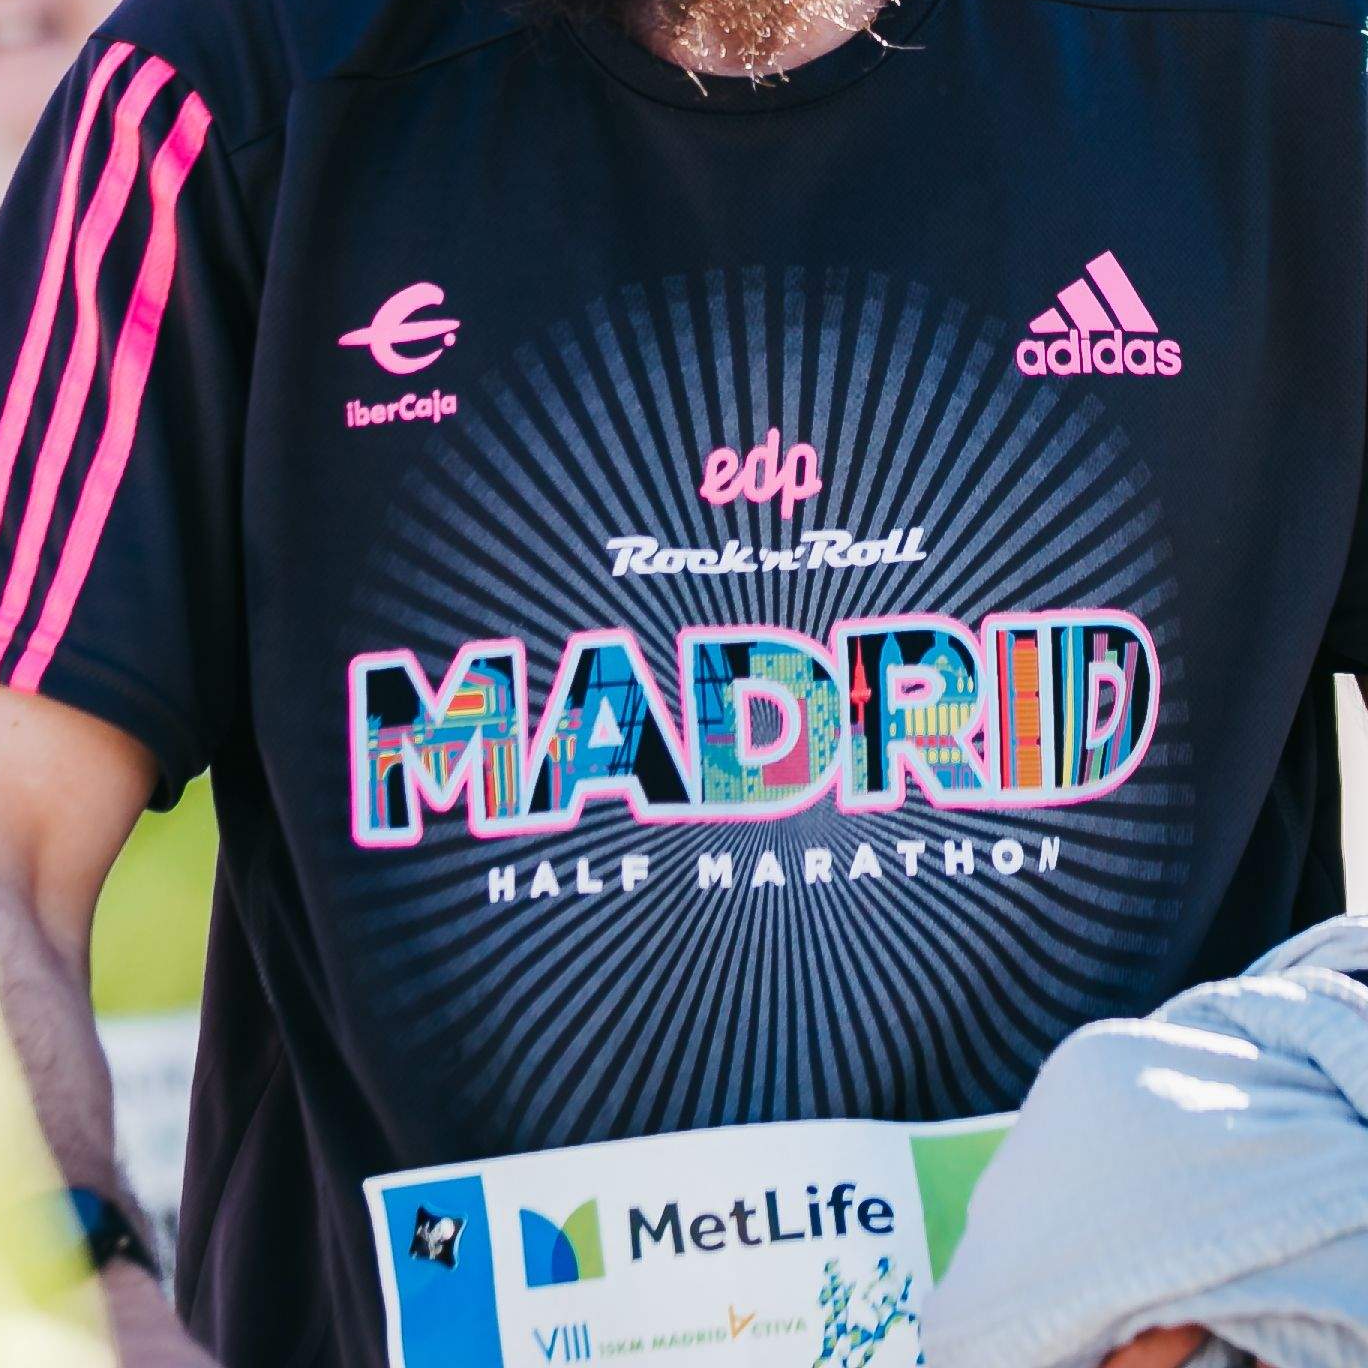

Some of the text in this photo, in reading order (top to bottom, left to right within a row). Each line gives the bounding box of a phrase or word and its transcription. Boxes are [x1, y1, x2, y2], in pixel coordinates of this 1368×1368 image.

[1015, 328, 1182, 376] adidas
[346, 389, 457, 428] iberCaja
[699, 427, 822, 520] edp
[348, 608, 1162, 848] MADRID
[488, 836, 1061, 904] HALF MARATHON
[628, 1182, 895, 1261] MetLife
[532, 1322, 592, 1363] VIII
